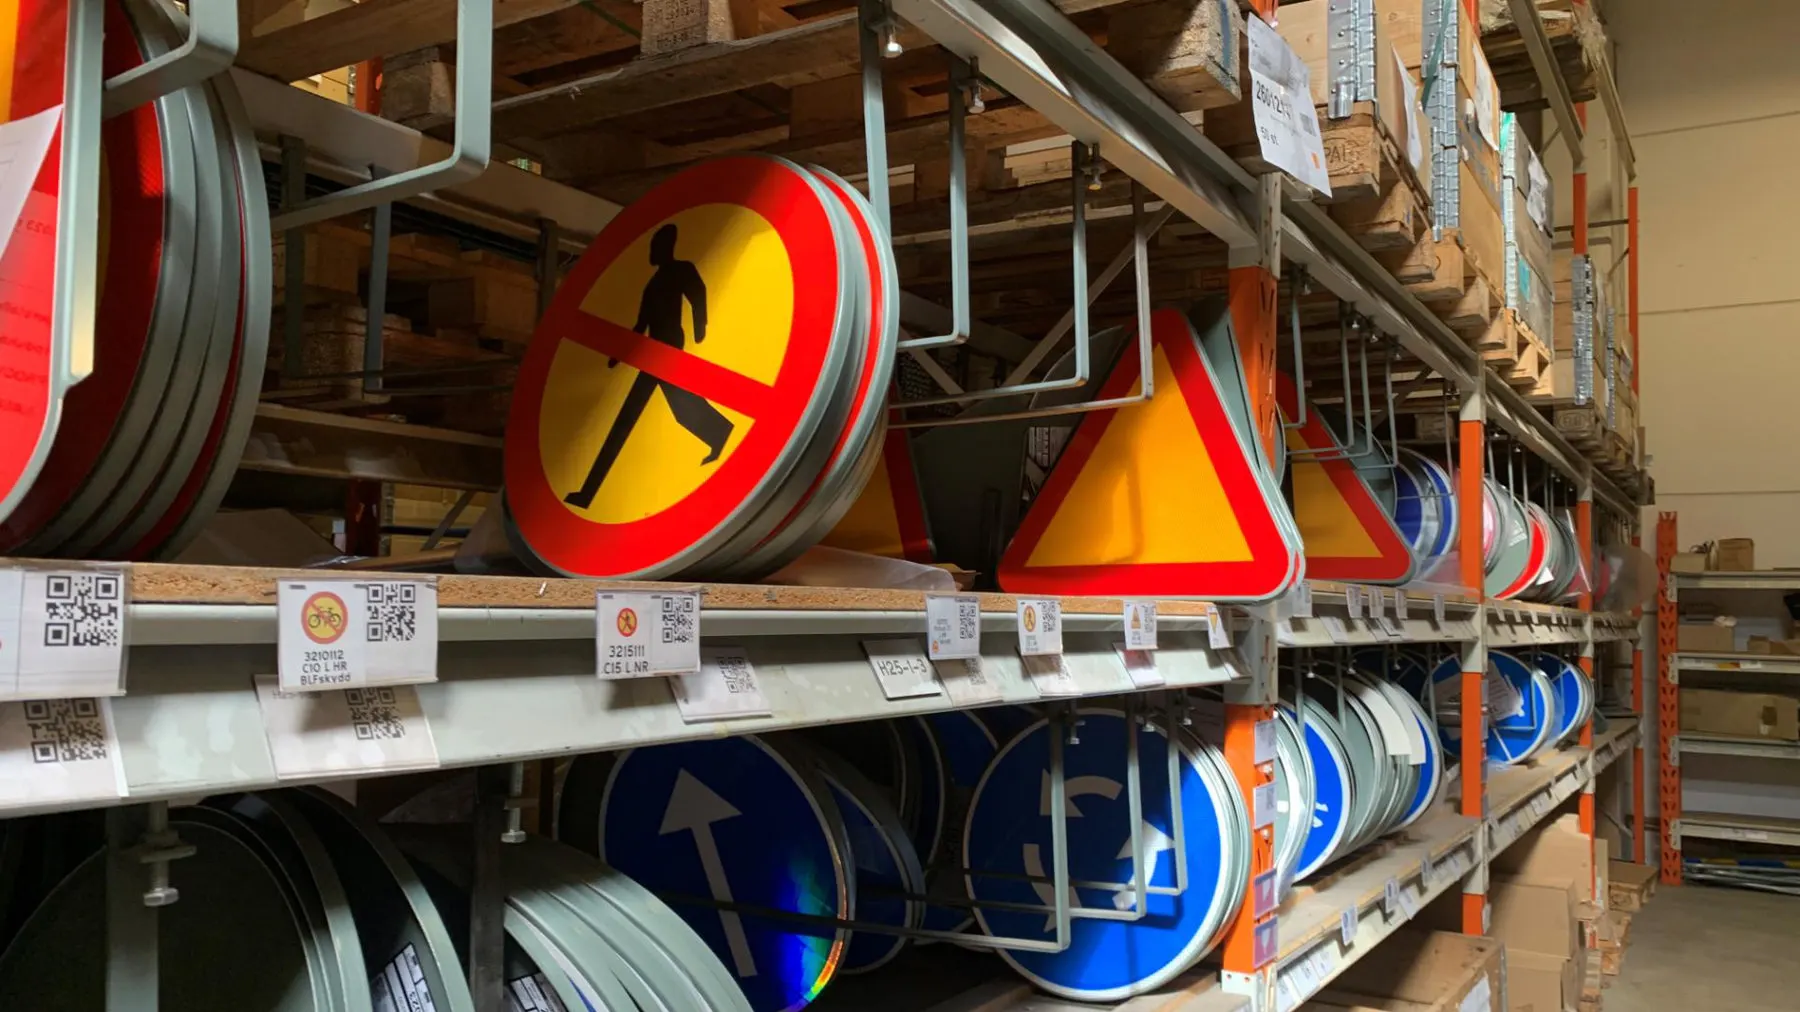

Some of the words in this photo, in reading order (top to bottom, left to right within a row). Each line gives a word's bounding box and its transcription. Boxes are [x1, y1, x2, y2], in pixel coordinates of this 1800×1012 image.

[304, 649, 345, 662] 3210112
[609, 644, 645, 658] 3215111
[302, 662, 321, 674] C10
[324, 661, 330, 672] L
[333, 660, 348, 671] HR
[603, 661, 622, 674] C15
[625, 661, 631, 673] L
[634, 660, 649, 672] NR
[877, 658, 927, 676] H25-1-3
